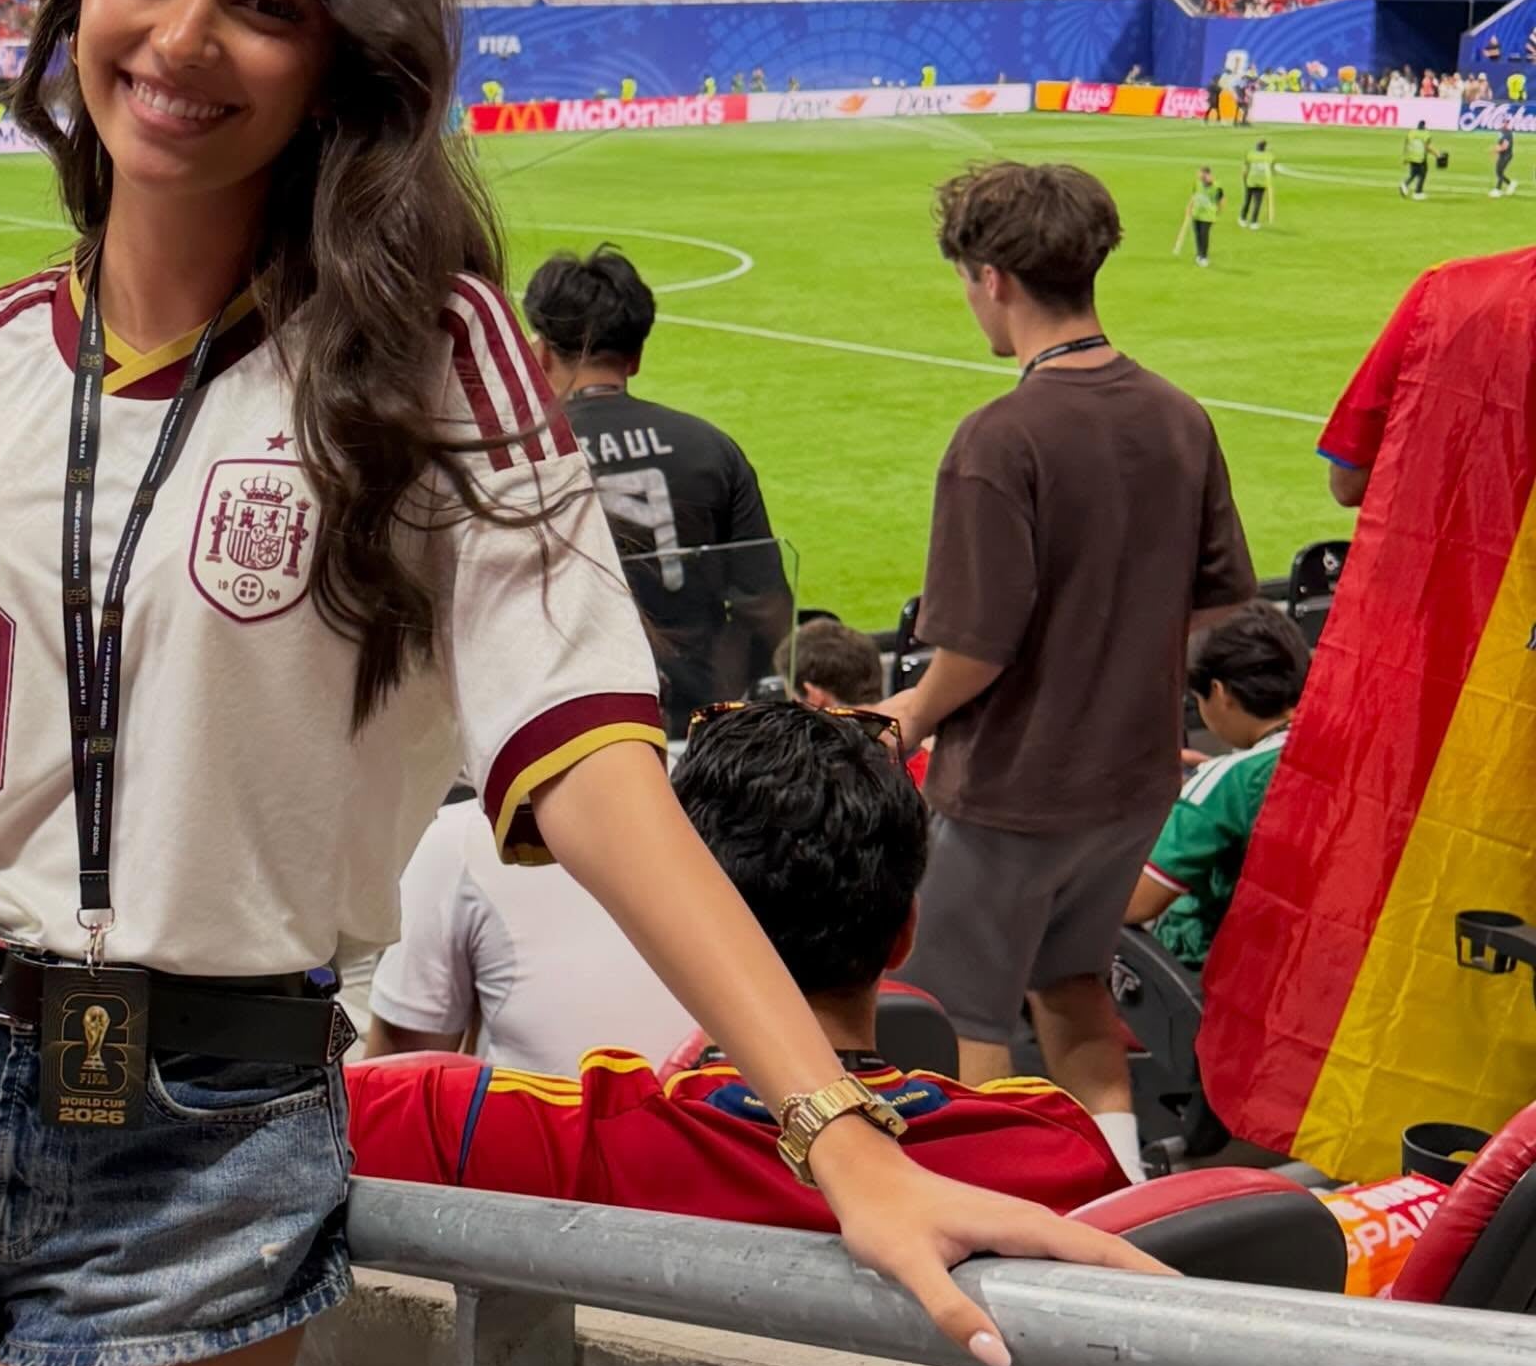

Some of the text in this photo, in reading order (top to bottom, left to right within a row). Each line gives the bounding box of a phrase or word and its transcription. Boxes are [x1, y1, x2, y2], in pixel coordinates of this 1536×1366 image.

[478, 37, 521, 55] FIFA
[555, 95, 725, 132] McDonald's
[1300, 96, 1400, 126] verizon
[80, 1072, 109, 1085] FIFA
[60, 1097, 126, 1108] WORLD CUP
[58, 1108, 126, 1124] 2026
